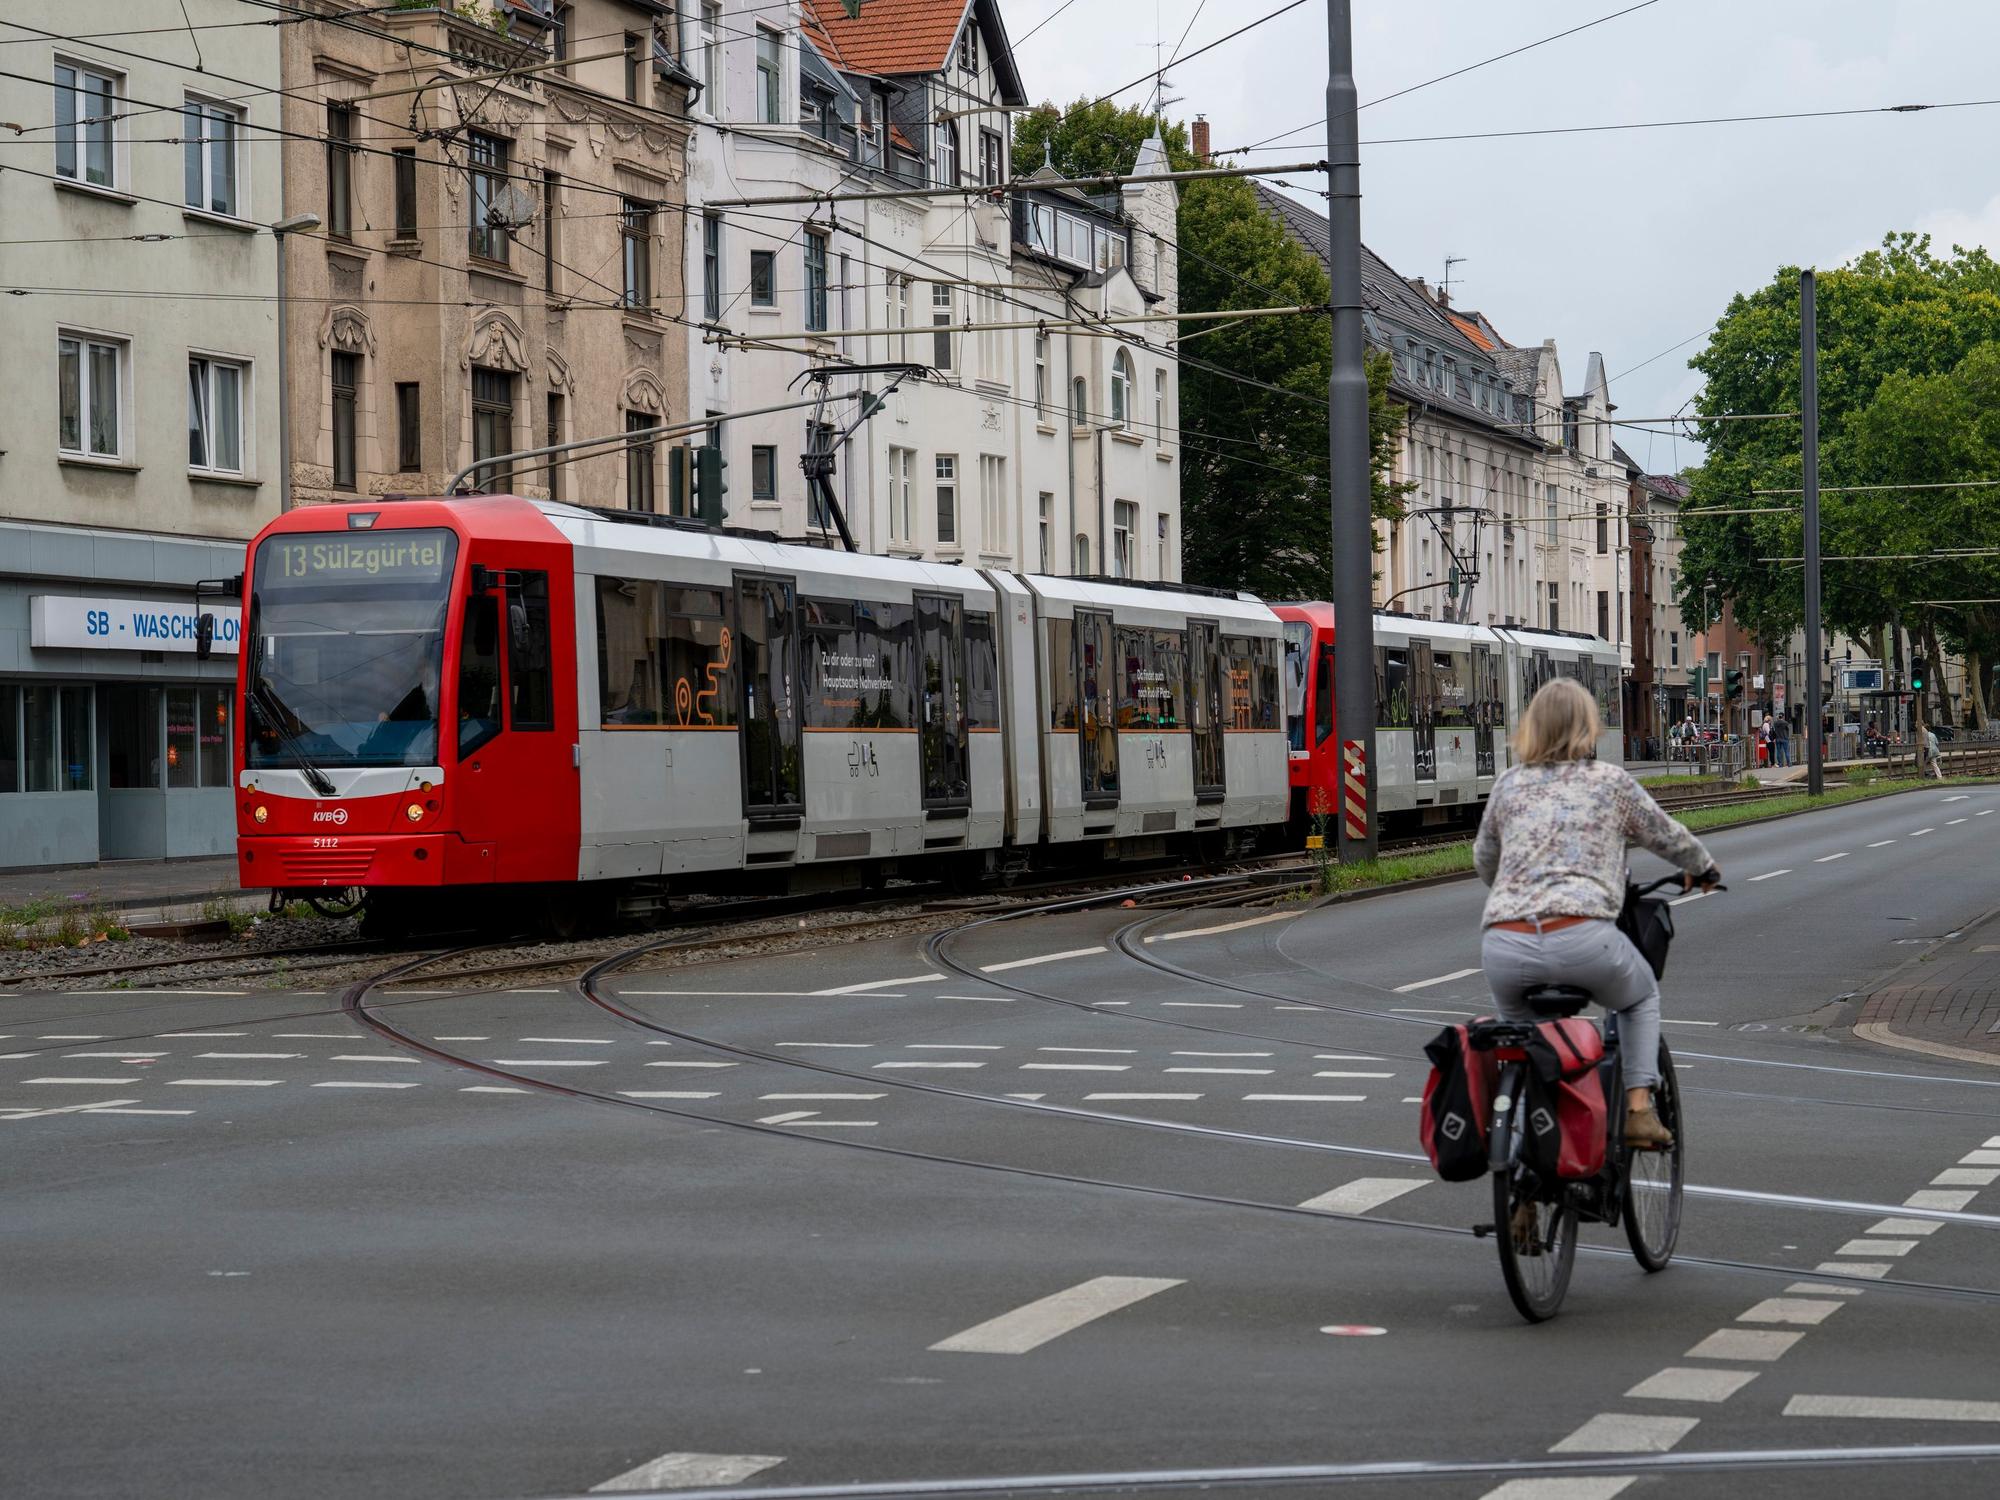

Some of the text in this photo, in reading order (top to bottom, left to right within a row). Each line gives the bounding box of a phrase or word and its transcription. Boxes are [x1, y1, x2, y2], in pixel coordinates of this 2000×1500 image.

[282, 539, 442, 577] 13 Sülzgürtel
[86, 610, 110, 636] SB
[132, 613, 240, 641] WASCHSLON
[840, 652, 854, 667] oder
[823, 673, 858, 692] Hauptsache
[313, 811, 333, 821] KVB
[313, 838, 338, 848] 5112
